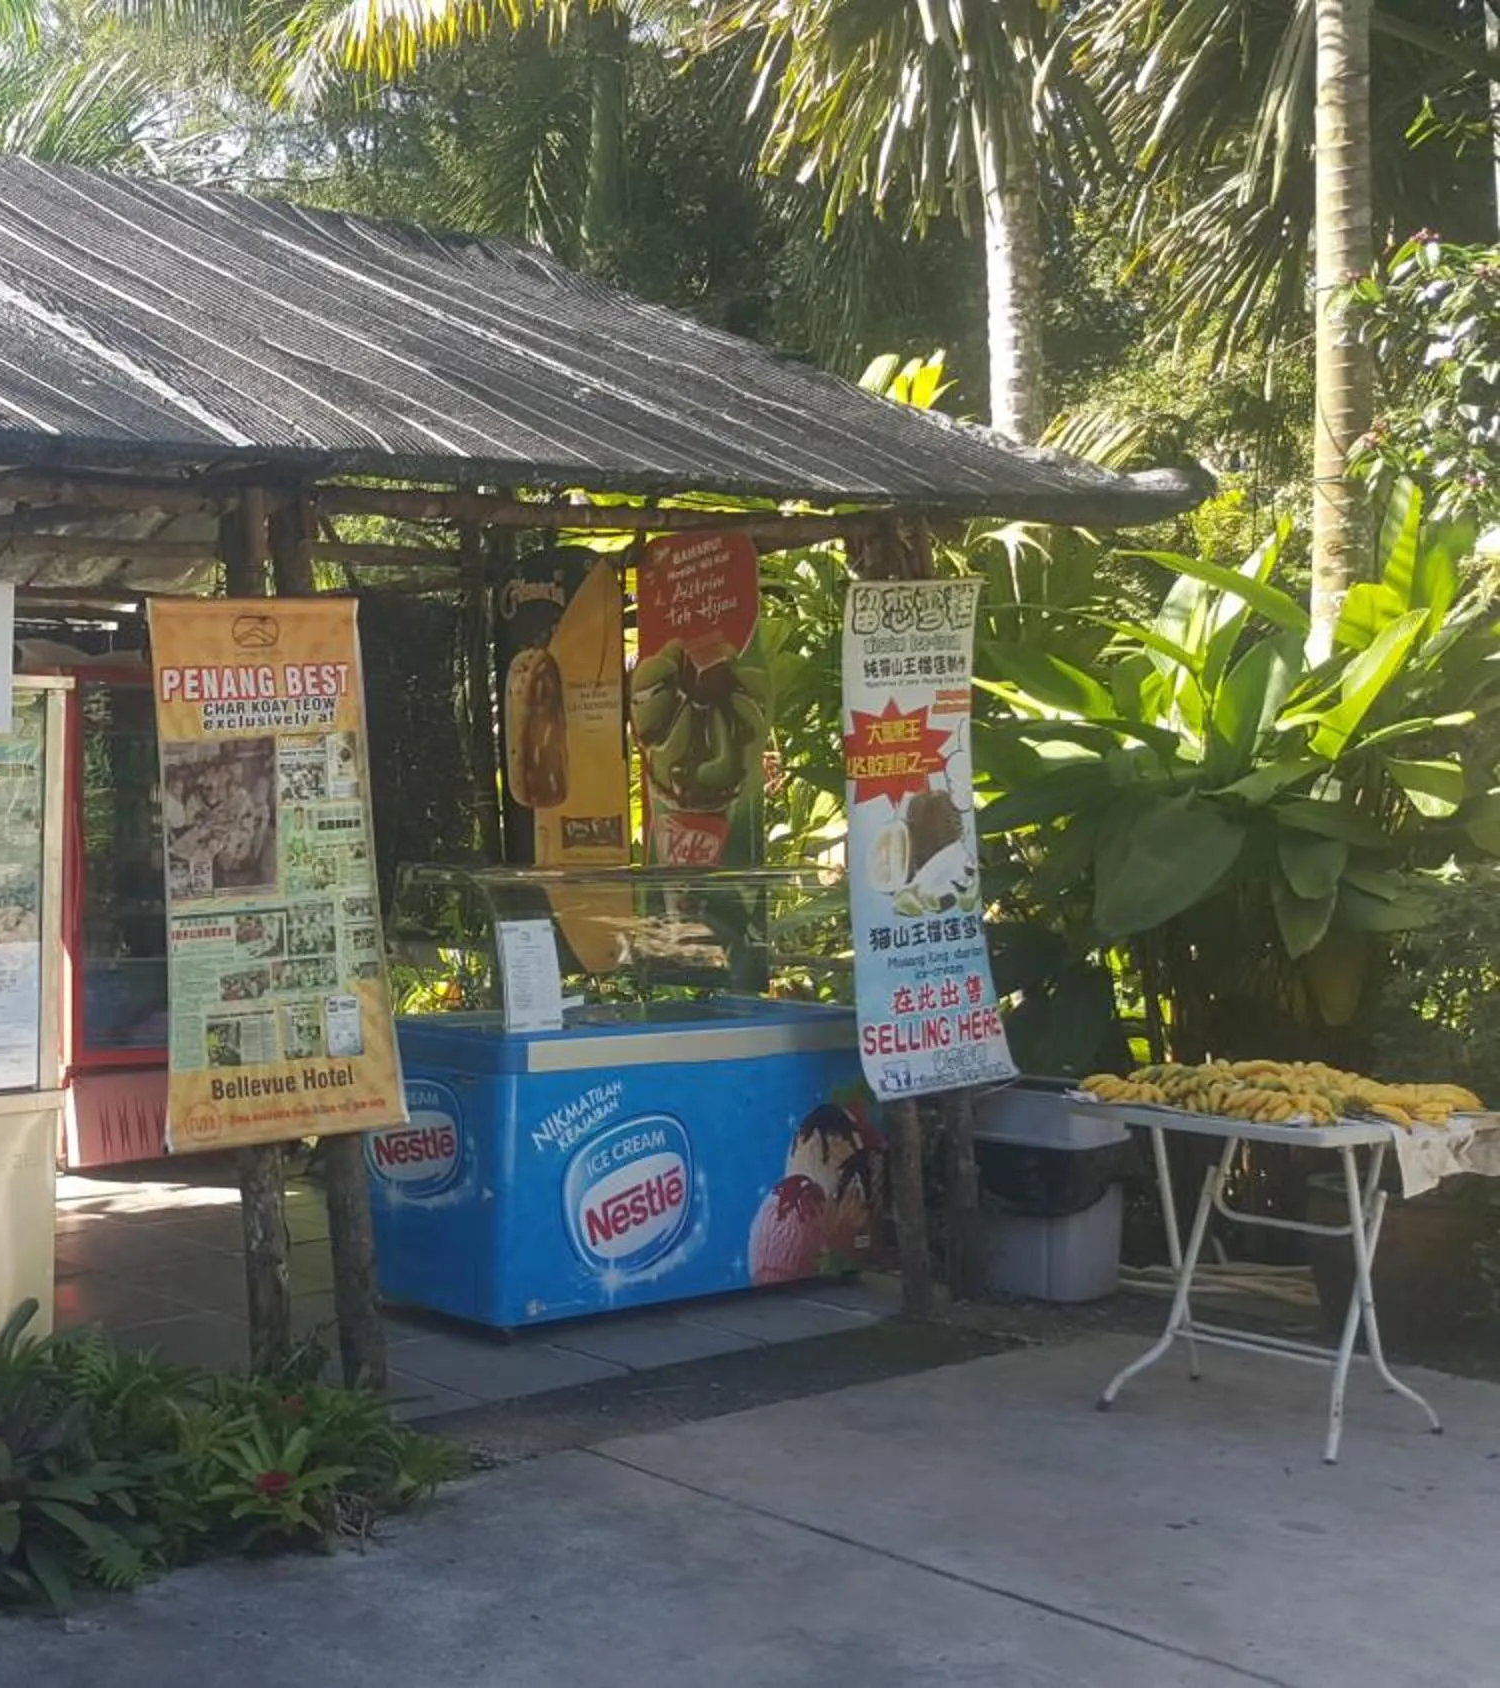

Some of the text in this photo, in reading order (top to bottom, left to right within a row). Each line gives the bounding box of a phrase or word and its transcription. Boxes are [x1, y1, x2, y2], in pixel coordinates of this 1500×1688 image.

[161, 662, 350, 702] PENANG BEST
[203, 698, 337, 717] CHAR KOAY TEOW
[203, 711, 336, 731] exclusively at
[893, 975, 983, 1015] 在此出售
[863, 1009, 1002, 1056] SELLING HERE
[211, 1064, 354, 1100] Bellevue Hotel
[586, 1129, 667, 1178] ICE CREAM
